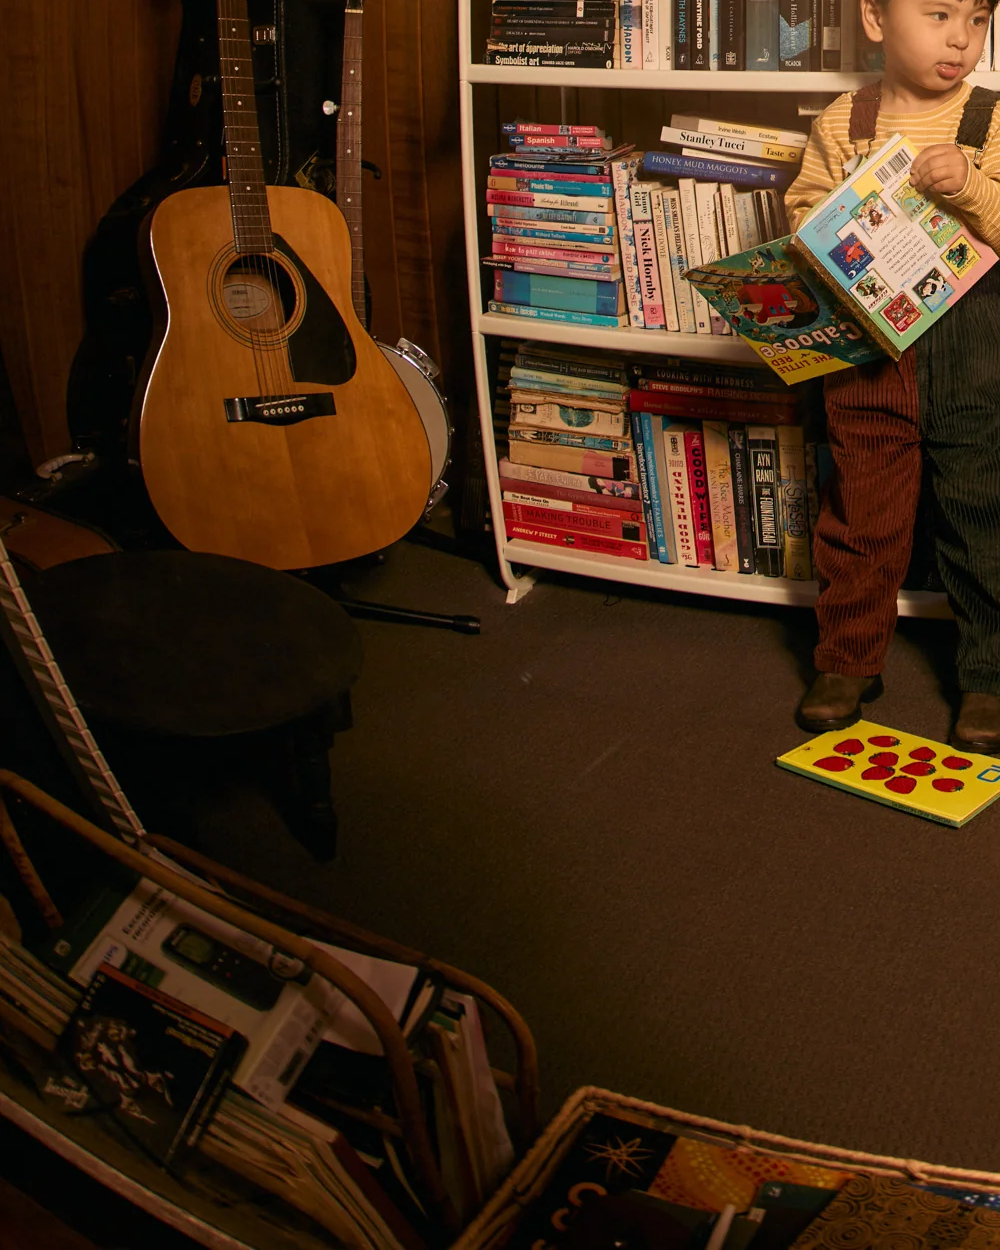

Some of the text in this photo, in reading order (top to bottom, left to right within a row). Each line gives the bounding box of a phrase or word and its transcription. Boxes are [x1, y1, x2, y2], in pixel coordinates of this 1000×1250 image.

[678, 10, 687, 43] HAYNES
[623, 25, 633, 64] HADDON
[696, 28, 704, 50] FORD
[495, 54, 540, 66] Symbolist art
[519, 124, 542, 132] Italian
[526, 136, 555, 145] Spanish
[679, 131, 786, 158] Stanley Tucci Taste
[706, 163, 749, 175] MAGGOTS
[639, 227, 657, 302] Nick Hornby
[759, 321, 864, 358] Caboose
[771, 355, 794, 366] RED
[777, 353, 834, 374] THE LITTLE
[651, 383, 669, 391] STEVE
[656, 369, 690, 381] COOKING
[715, 376, 754, 388] KINDNESS
[757, 453, 771, 467] AYN
[755, 469, 774, 483] RAND
[525, 509, 611, 530] MAKING TROUBLE
[759, 496, 777, 544] FOUNTAINHEAD
